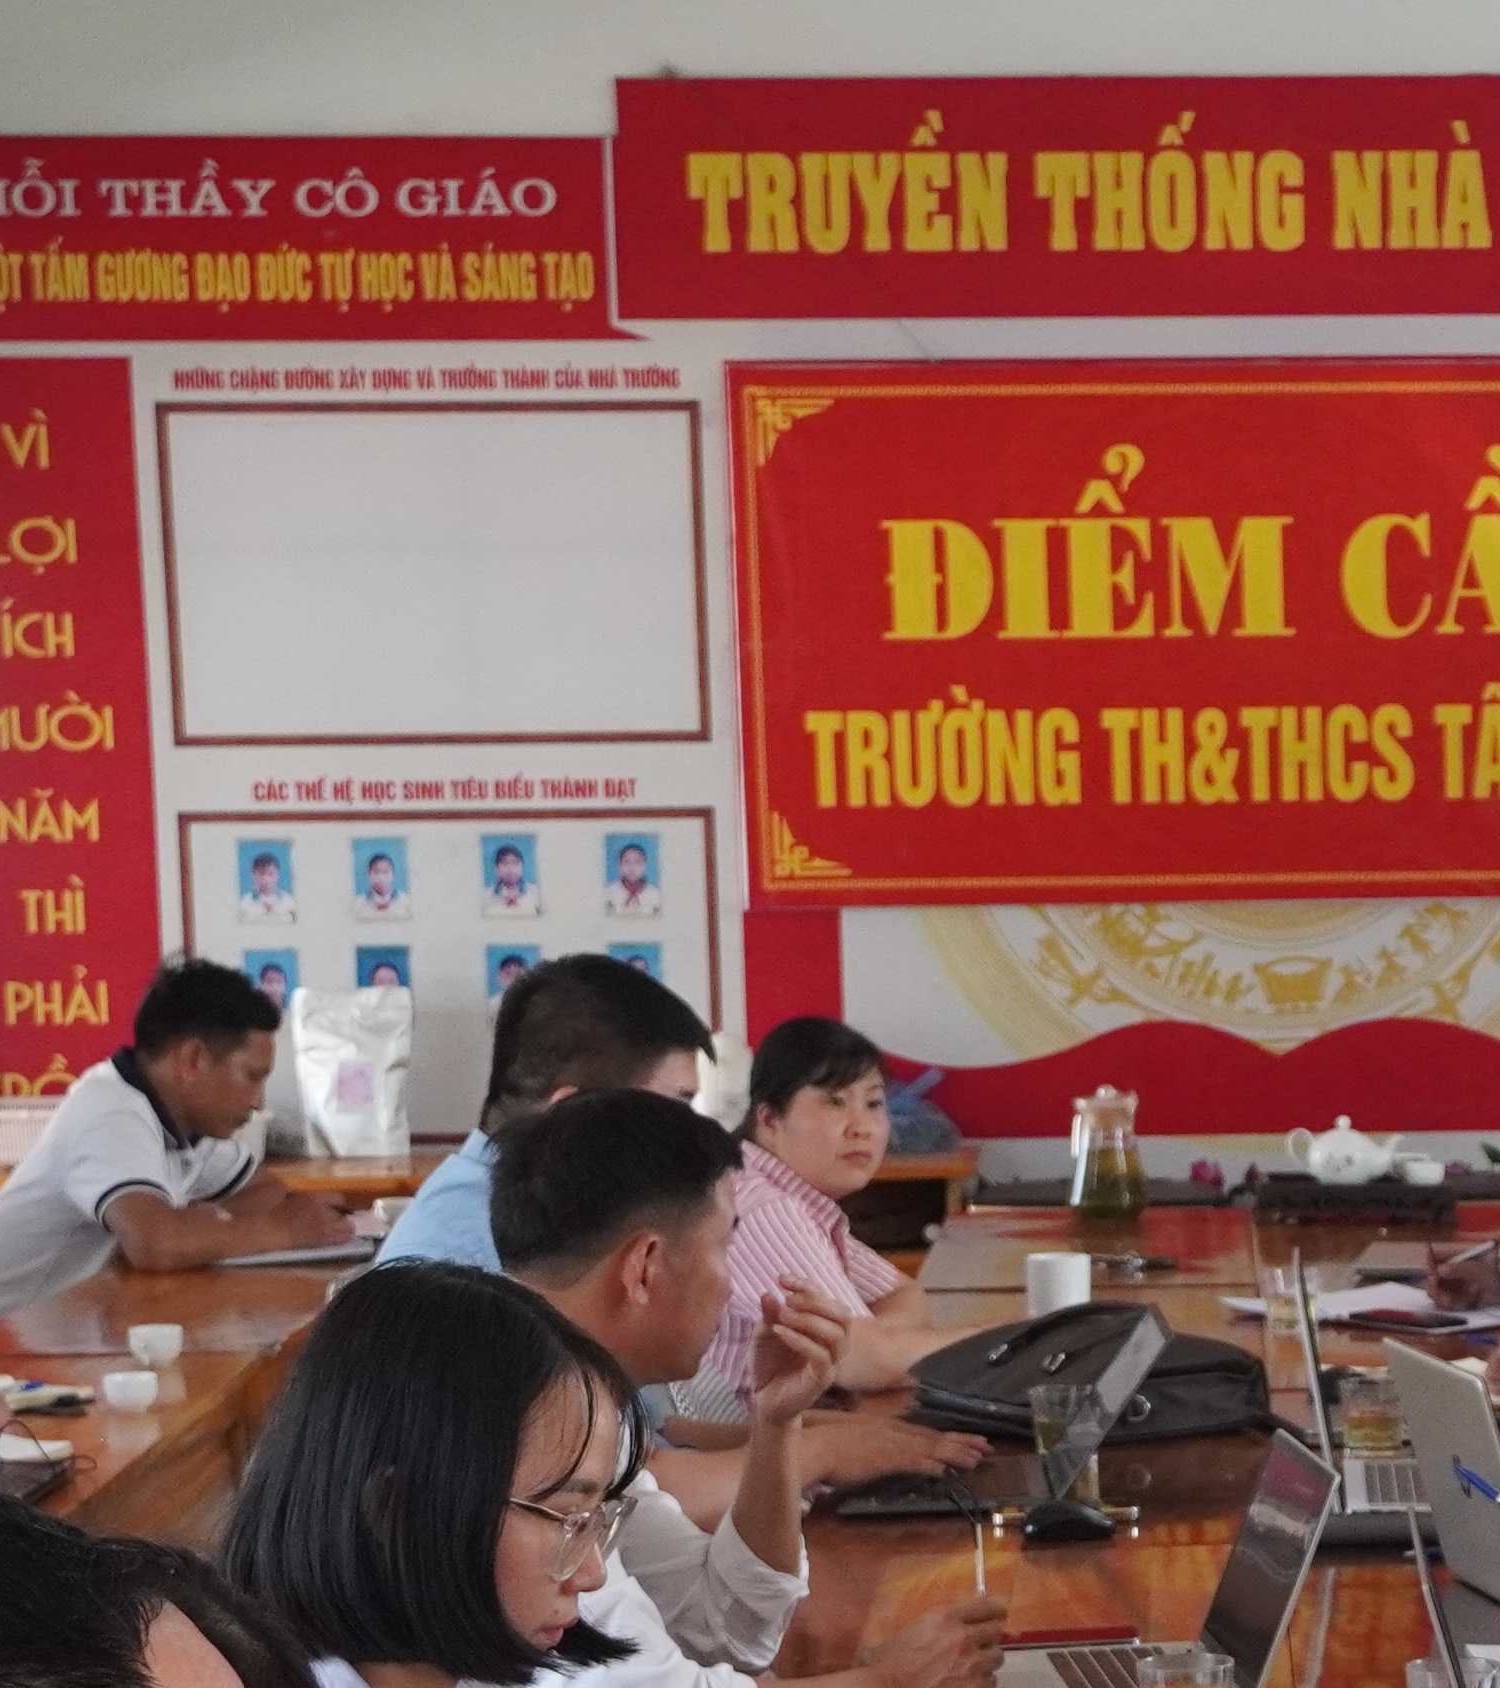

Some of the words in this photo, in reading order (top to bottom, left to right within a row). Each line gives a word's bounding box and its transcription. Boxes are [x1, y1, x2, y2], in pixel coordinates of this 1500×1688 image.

[100, 157, 276, 219] THẦY
[293, 167, 381, 219] CÔ
[395, 166, 559, 219] GIÁO
[688, 110, 1009, 256] TRUYỀN
[1035, 110, 1307, 254] THỐNG
[1333, 120, 1494, 252] NHÀ
[30, 238, 91, 304] TẤM
[97, 250, 192, 304] GƯƠNG
[196, 252, 253, 314] ĐẠO
[257, 244, 314, 304] ĐỨC
[318, 251, 359, 314] TỰ
[359, 253, 416, 314] HỌC
[418, 242, 458, 303] VÀ
[462, 244, 539, 304] SÁNG
[543, 252, 597, 313] TẠO
[0, 406, 53, 470] VÌ
[880, 443, 1298, 642] ĐIỂM
[0, 596, 79, 660] ÍCH
[802, 682, 1084, 810] TRƯỜNG
[1100, 702, 1417, 806] TH&THCS
[253, 778, 289, 802] CÁC
[294, 775, 326, 802] THẾ
[332, 777, 354, 805] HỆ
[361, 780, 397, 804] HỌC
[402, 780, 447, 801] SINH
[540, 776, 599, 800] THÀNH
[603, 777, 638, 802] ĐẠT
[18, 872, 89, 936] THÌ
[3, 962, 113, 1028] PHẢI
